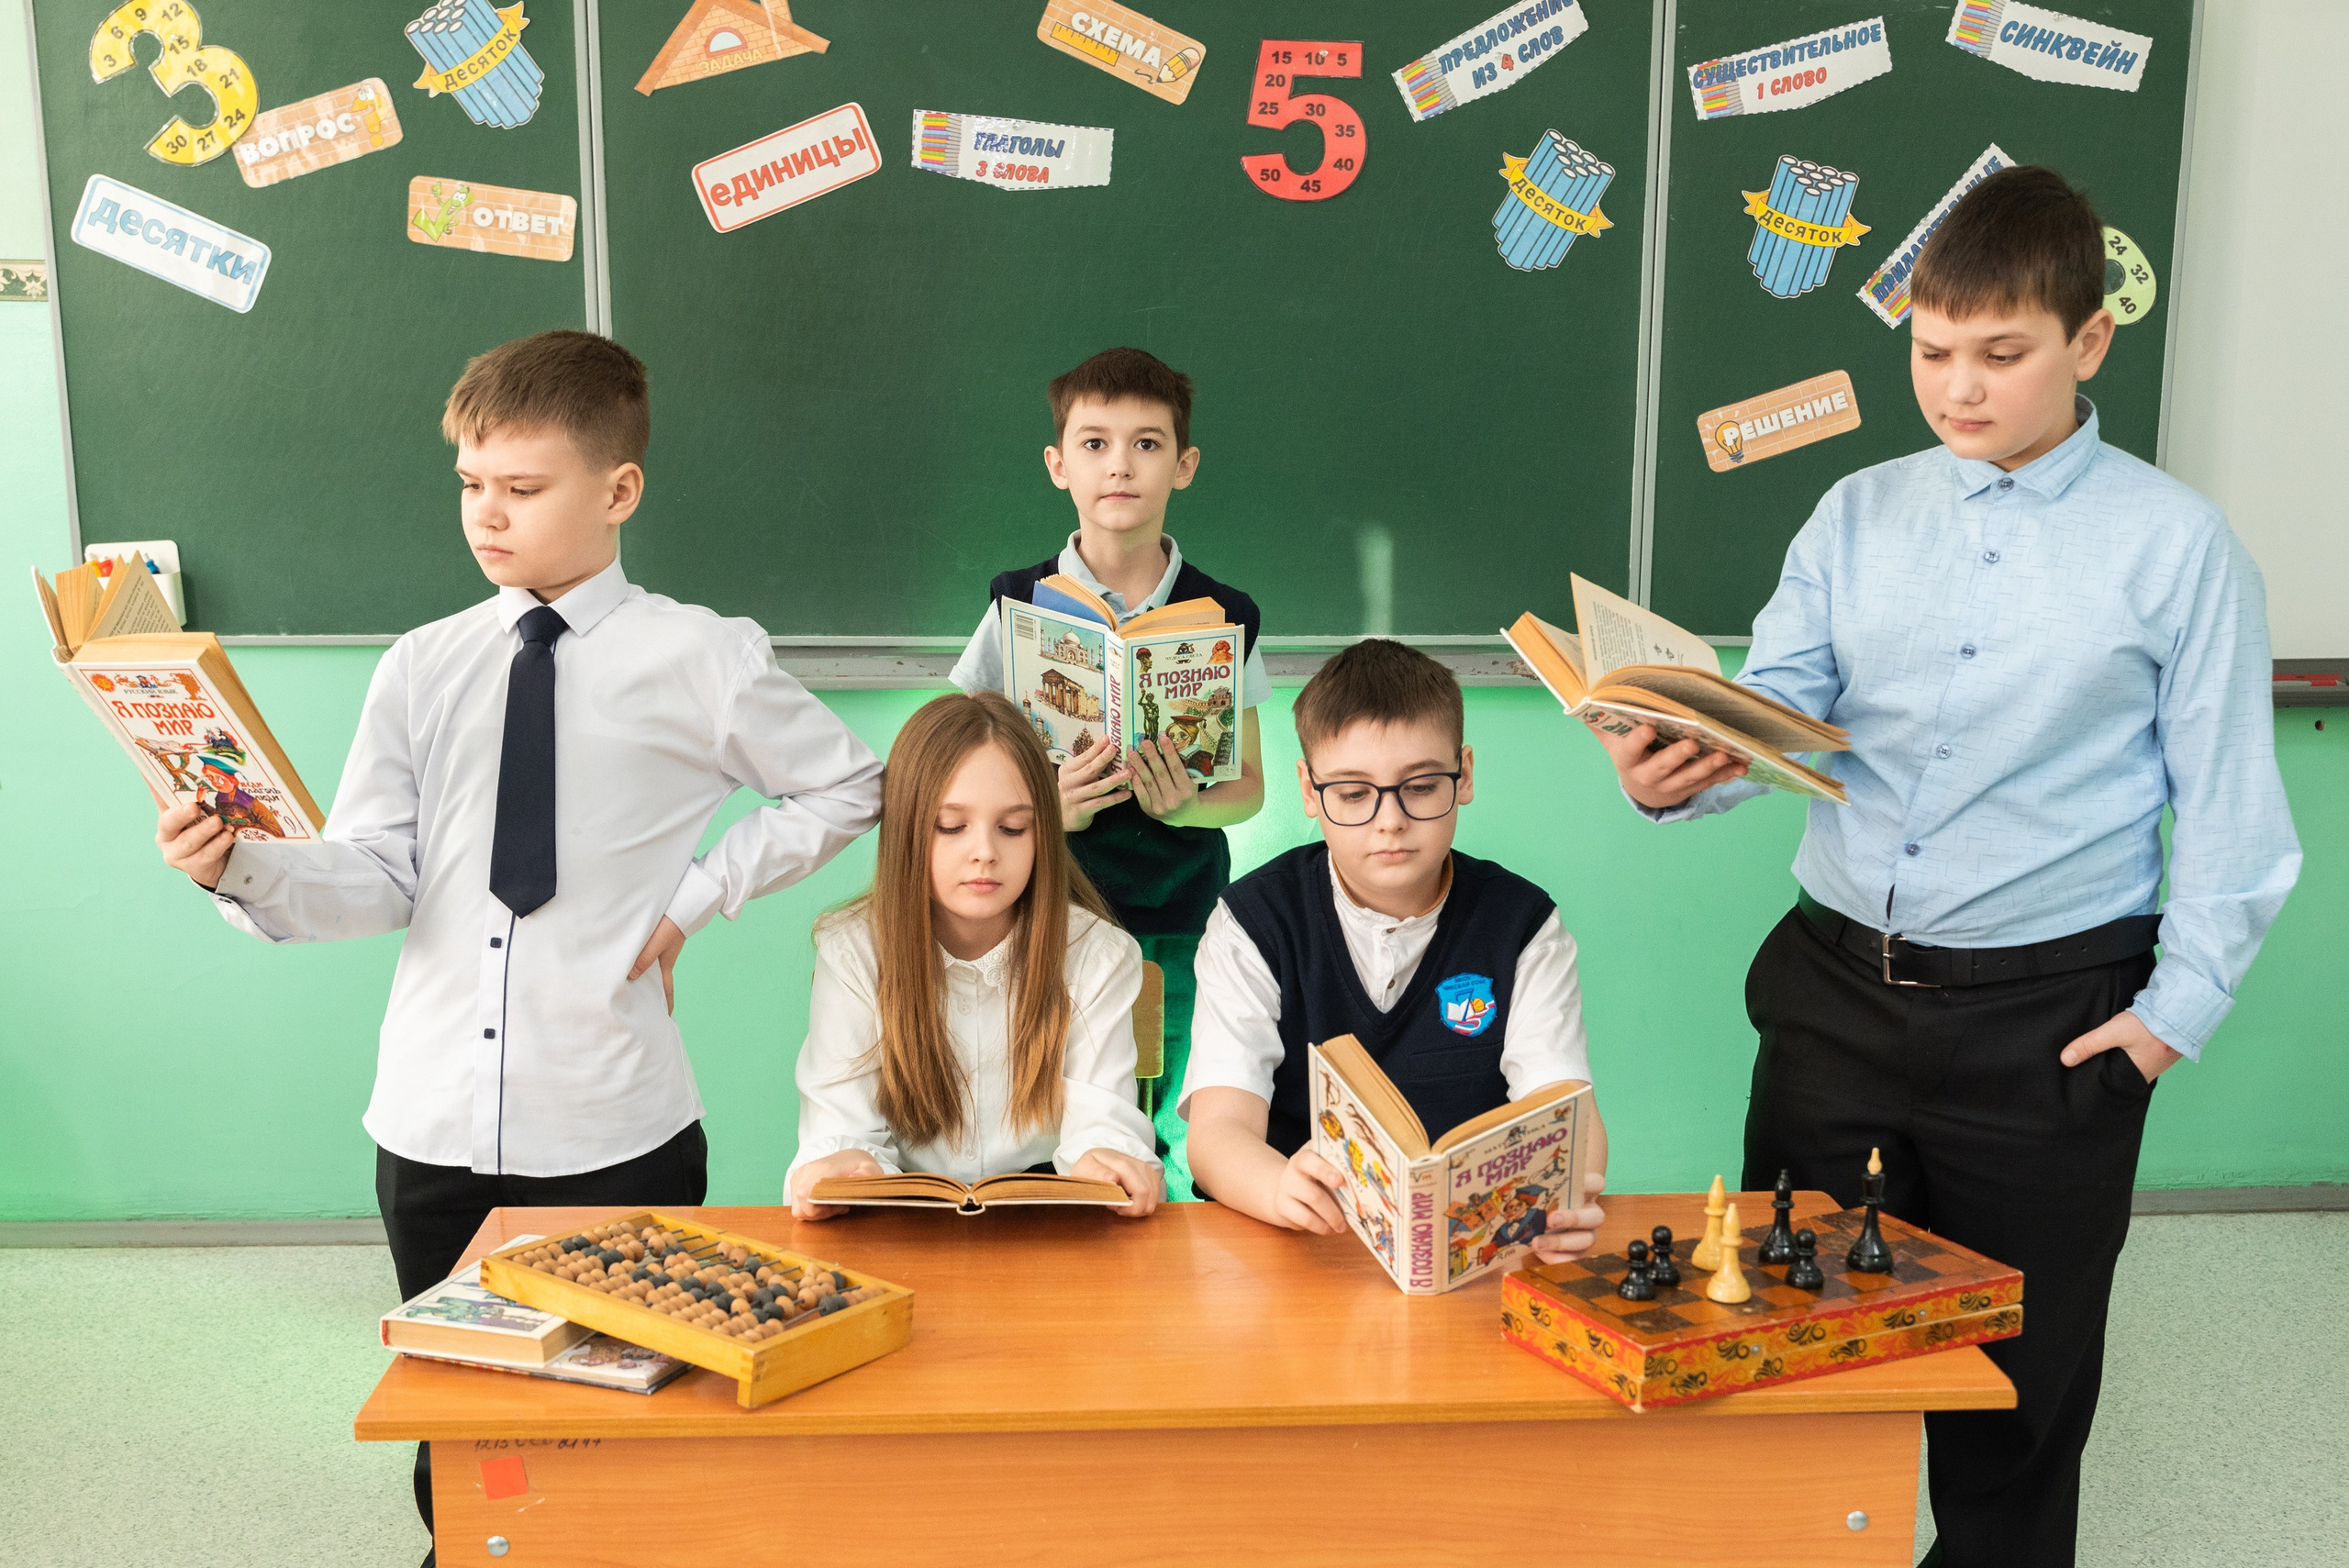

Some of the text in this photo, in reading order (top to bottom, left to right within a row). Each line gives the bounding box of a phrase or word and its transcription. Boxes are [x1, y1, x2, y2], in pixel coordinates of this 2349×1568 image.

[135, 7, 148, 21] 9
[161, 3, 184, 23] 12
[111, 26, 124, 39] 6
[1071, 12, 1162, 70] СХЕМА
[168, 34, 191, 55] 15
[1998, 19, 2139, 75] СИНКВЕЙН
[104, 54, 117, 68] 3
[698, 48, 763, 74] ЗАДАЧА
[1271, 51, 1292, 64] 15
[1305, 52, 1325, 65] 10
[1337, 53, 1347, 66] 5
[1472, 26, 1564, 89] ИЗ 4 СЛОВ
[1692, 23, 1882, 90] СУЩЕСТВИТЕЛЬНОЕ
[185, 59, 207, 78] 18
[218, 69, 241, 89] 21
[1265, 74, 1286, 87] 20
[1756, 67, 1827, 100] 1 СЛОВО
[223, 108, 247, 129] 24
[1258, 102, 1279, 116] 25
[1305, 103, 1326, 117] 30
[239, 113, 356, 165] ВОПРОС
[1334, 124, 1355, 138] 35
[166, 134, 188, 156] 30
[196, 131, 217, 152] 27
[973, 131, 1065, 159] ГЛАГОЛЫ
[710, 128, 868, 207] единицы
[975, 161, 1050, 183] 3 СЛОВА
[1260, 168, 1281, 182] 50
[1333, 158, 1354, 172] 40
[1300, 180, 1321, 193] 45
[473, 206, 563, 237] ОТВЕТ
[89, 196, 260, 286] десятки
[2109, 236, 2127, 255] 24
[2131, 264, 2149, 284] 32
[2119, 296, 2136, 314] 40
[1722, 391, 1849, 447] РЕШЕНИЕ
[1139, 665, 1230, 688] Я ПОЗНАЮ
[1109, 674, 1121, 707] МИР
[1164, 682, 1203, 699] МИР
[112, 701, 215, 718] Я ПОЗНАЮ
[152, 720, 195, 735] МИР
[1601, 721, 1632, 737] ИР
[1110, 762, 1123, 773] Я
[1455, 1169, 1472, 1188] Я
[1477, 1128, 1568, 1177] ПОЗНАЮ
[1485, 1155, 1532, 1186] МИР
[1409, 1193, 1433, 1287] Я ПОЗНАЮ МИР
